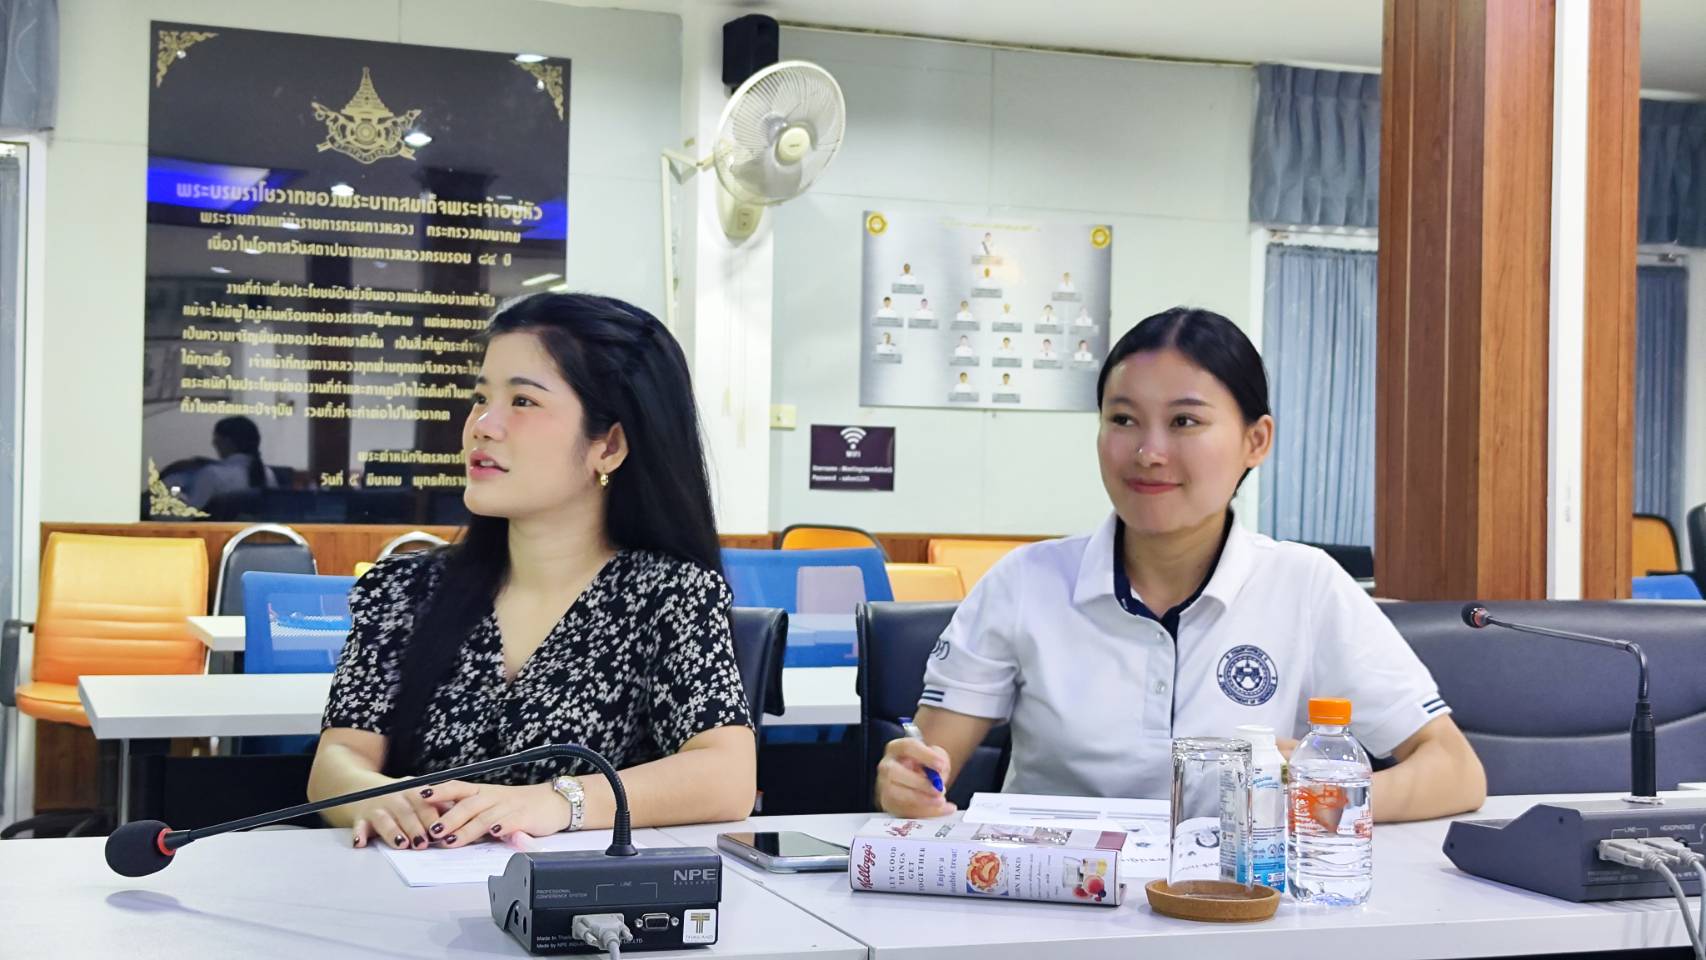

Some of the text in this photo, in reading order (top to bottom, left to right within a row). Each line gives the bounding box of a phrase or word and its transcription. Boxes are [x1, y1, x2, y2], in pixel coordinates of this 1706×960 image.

[176, 181, 543, 224] พระบรมราโชวาทของพระบาทสมเด็จพระเจ้าอยู่หัว
[426, 225, 521, 243] กระทรวงคมนาคม
[673, 868, 716, 882] NPE
[856, 842, 876, 889] Kellogg's
